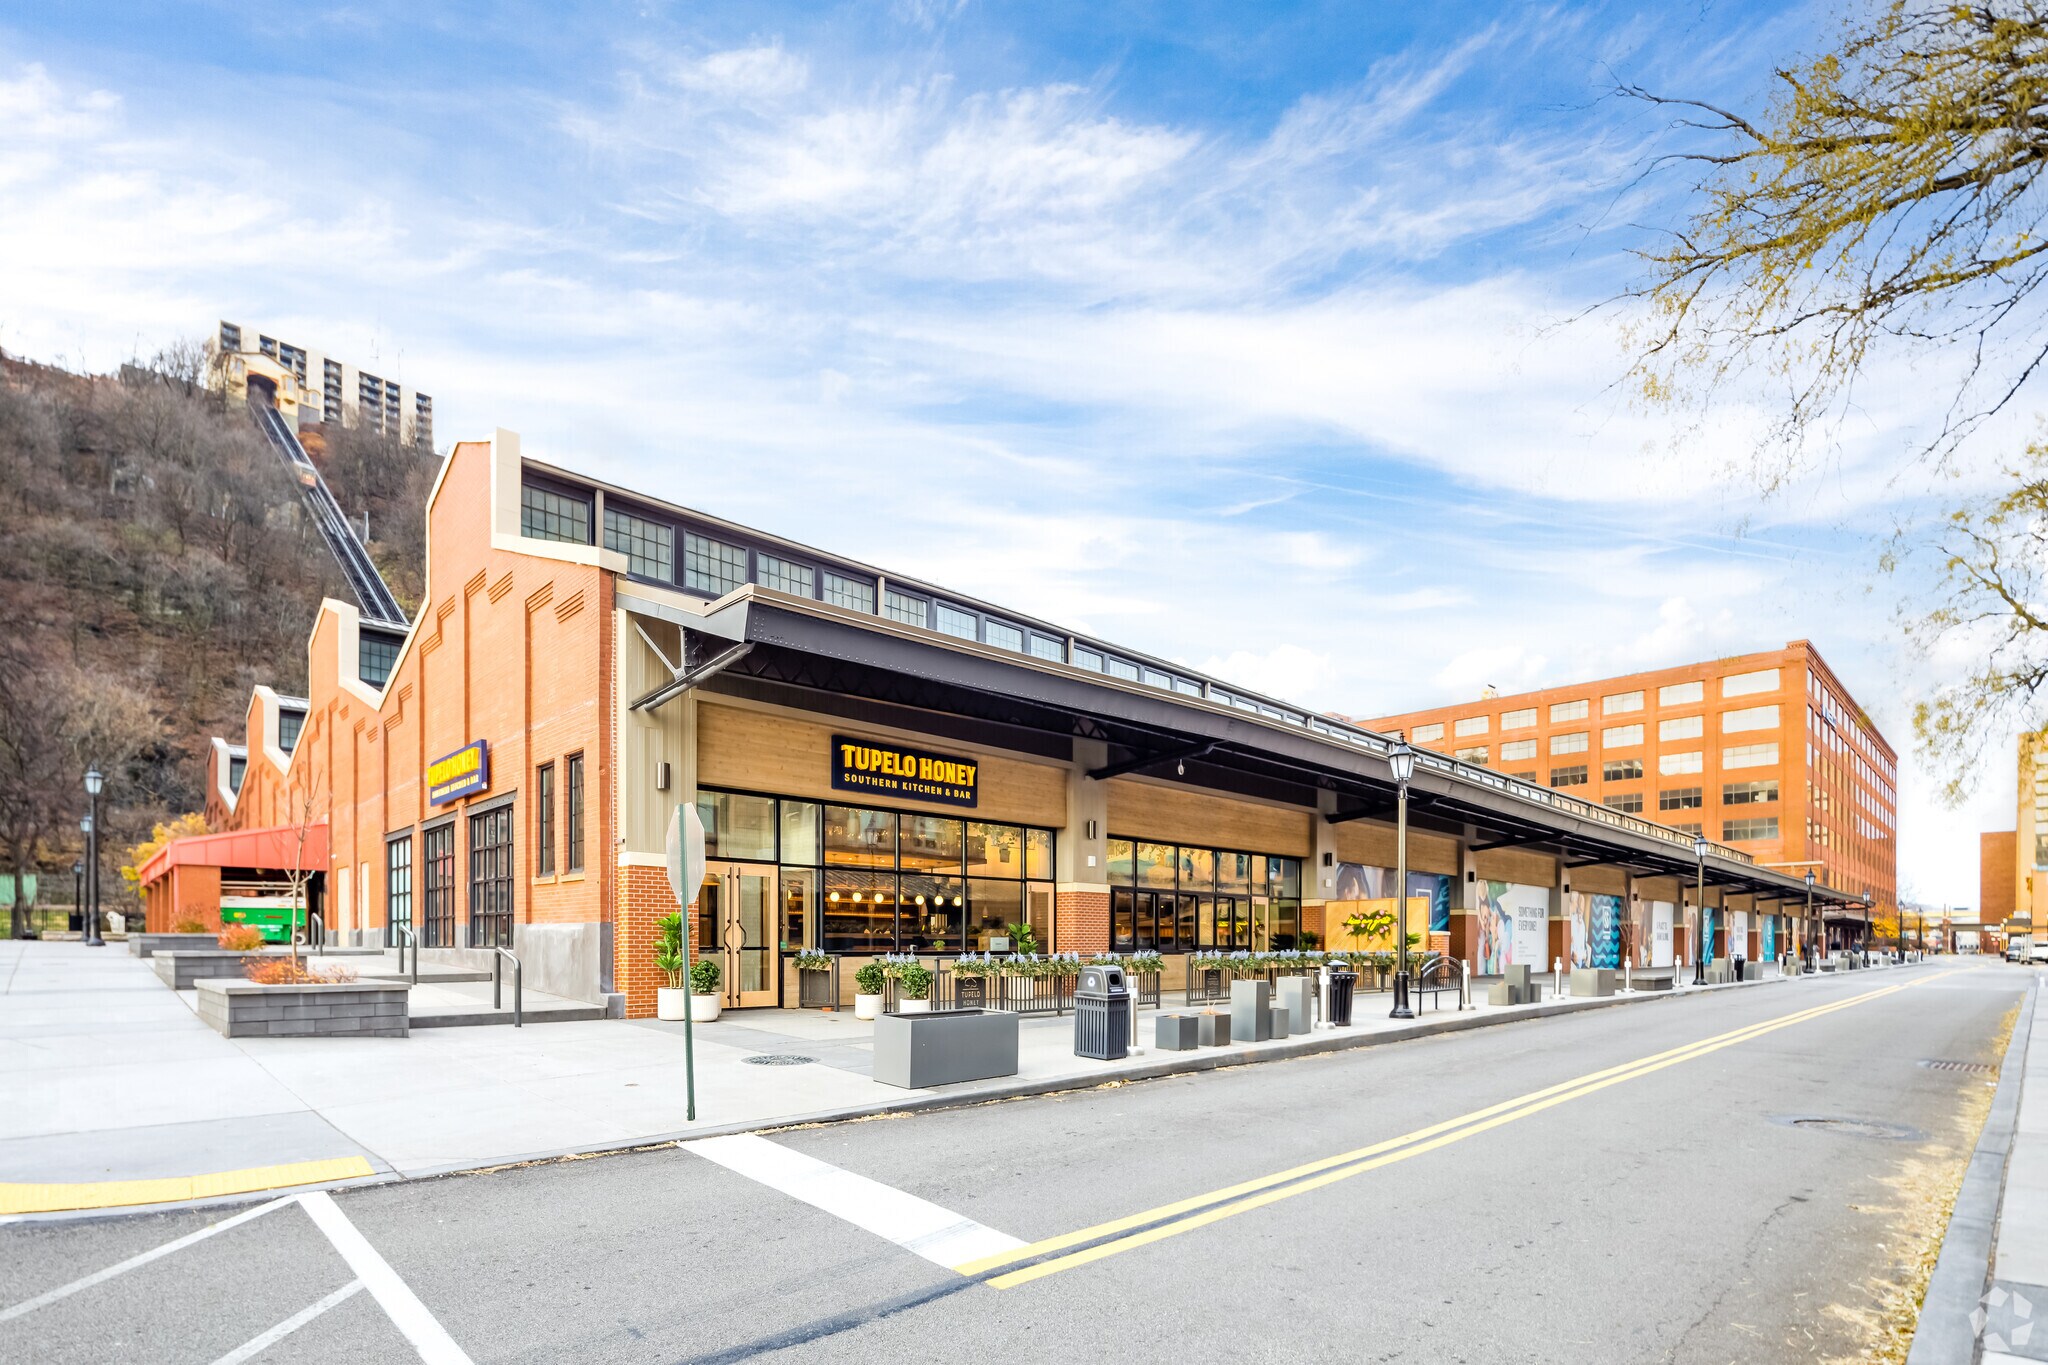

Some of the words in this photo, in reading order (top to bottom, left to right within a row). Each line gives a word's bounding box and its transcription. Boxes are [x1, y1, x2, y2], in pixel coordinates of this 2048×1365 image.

[841, 744, 916, 778] TUPELO
[919, 758, 976, 787] HONEY
[844, 773, 898, 789] SOUTHERN
[902, 782, 942, 796] KITCHEN
[945, 788, 951, 797] &
[953, 789, 971, 800] BAR
[961, 990, 981, 999] TUPELO
